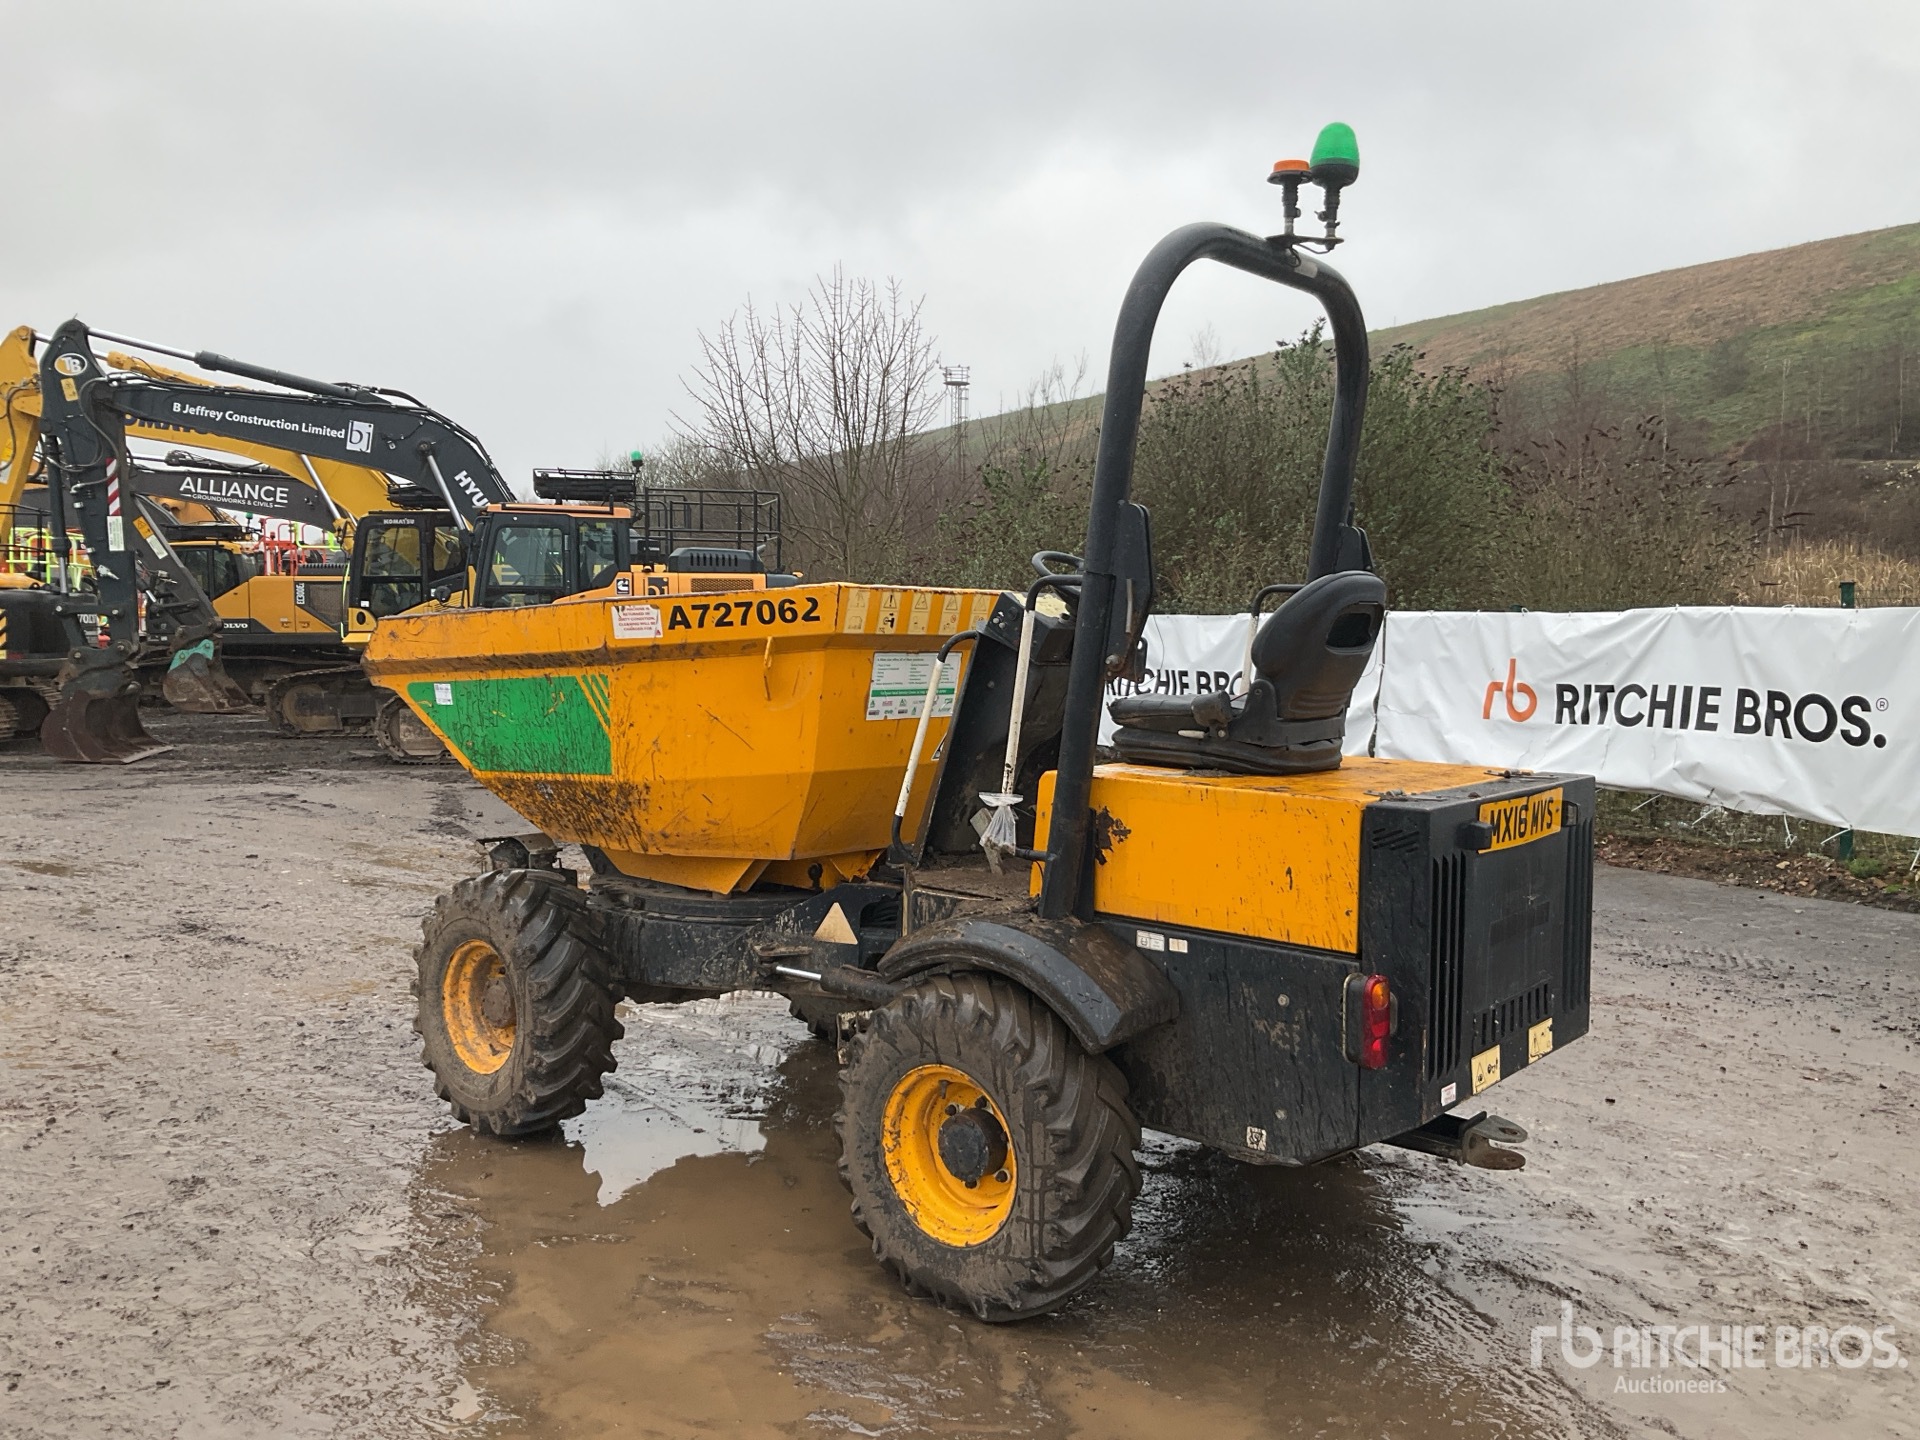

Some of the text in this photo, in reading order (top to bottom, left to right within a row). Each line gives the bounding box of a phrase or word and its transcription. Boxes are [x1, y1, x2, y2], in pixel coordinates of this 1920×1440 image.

[172, 402, 181, 413] B
[182, 404, 223, 421] Jeffrey
[225, 411, 299, 431] Construction
[301, 422, 345, 439] Limited
[179, 476, 290, 504] ALLIANCE
[192, 493, 246, 506] GROUNDWORKS
[454, 470, 491, 507] HYU
[383, 517, 415, 525] KOMATSU
[667, 596, 821, 631] A727062
[1195, 670, 1243, 696] BRO
[1482, 658, 1538, 723] rb
[1554, 683, 1722, 732] RITCHIE
